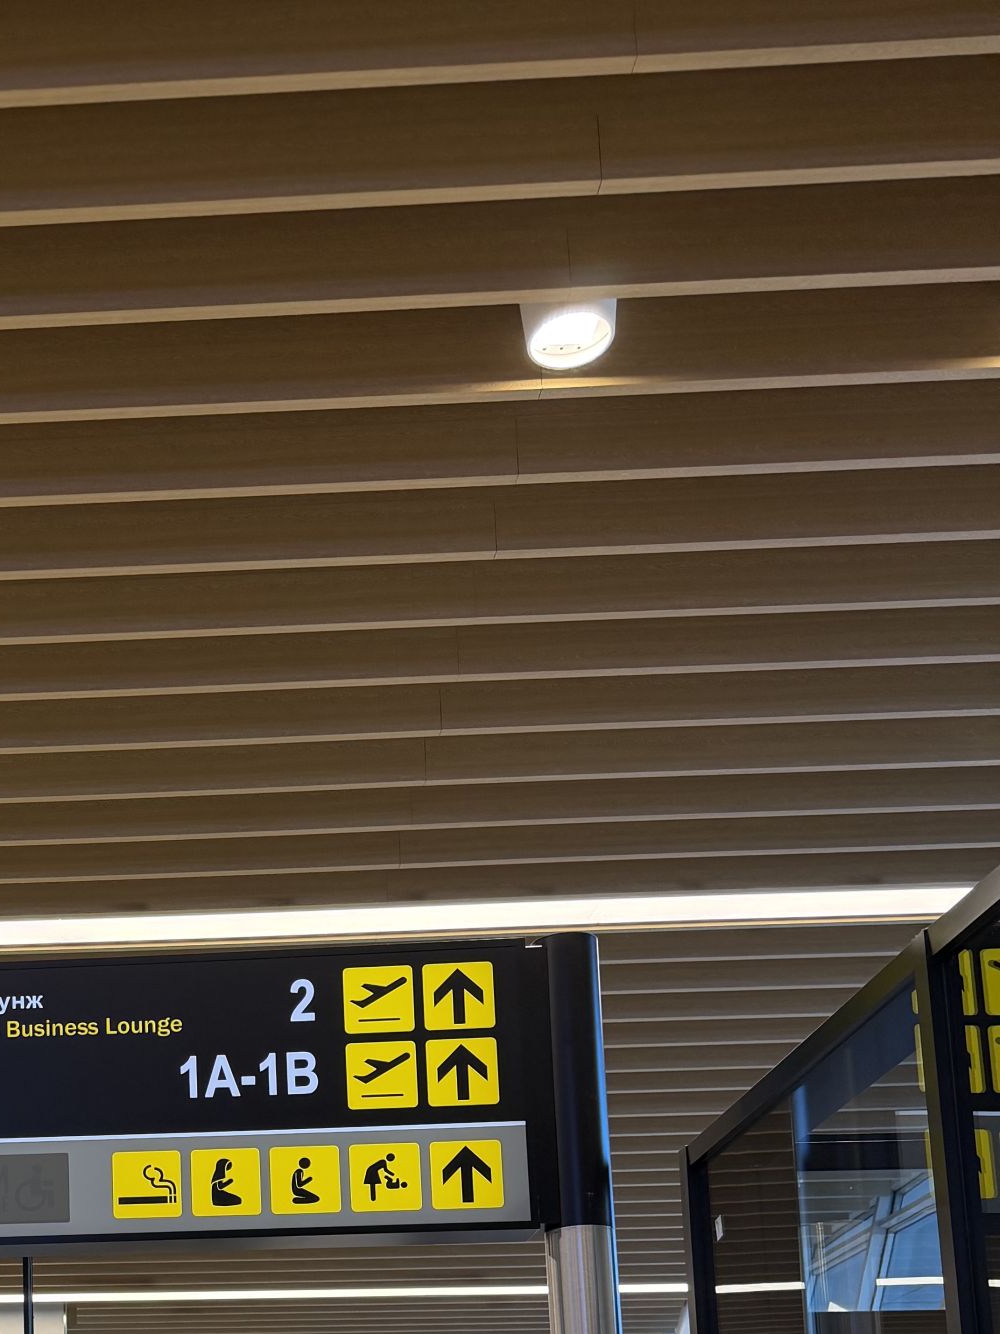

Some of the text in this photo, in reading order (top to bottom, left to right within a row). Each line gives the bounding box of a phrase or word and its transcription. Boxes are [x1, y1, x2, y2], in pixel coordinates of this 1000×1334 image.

[290, 978, 315, 1022] 2
[6, 1019, 99, 1039] Business
[105, 1016, 183, 1038] Lounge
[180, 1051, 319, 1100] 1A-1B
